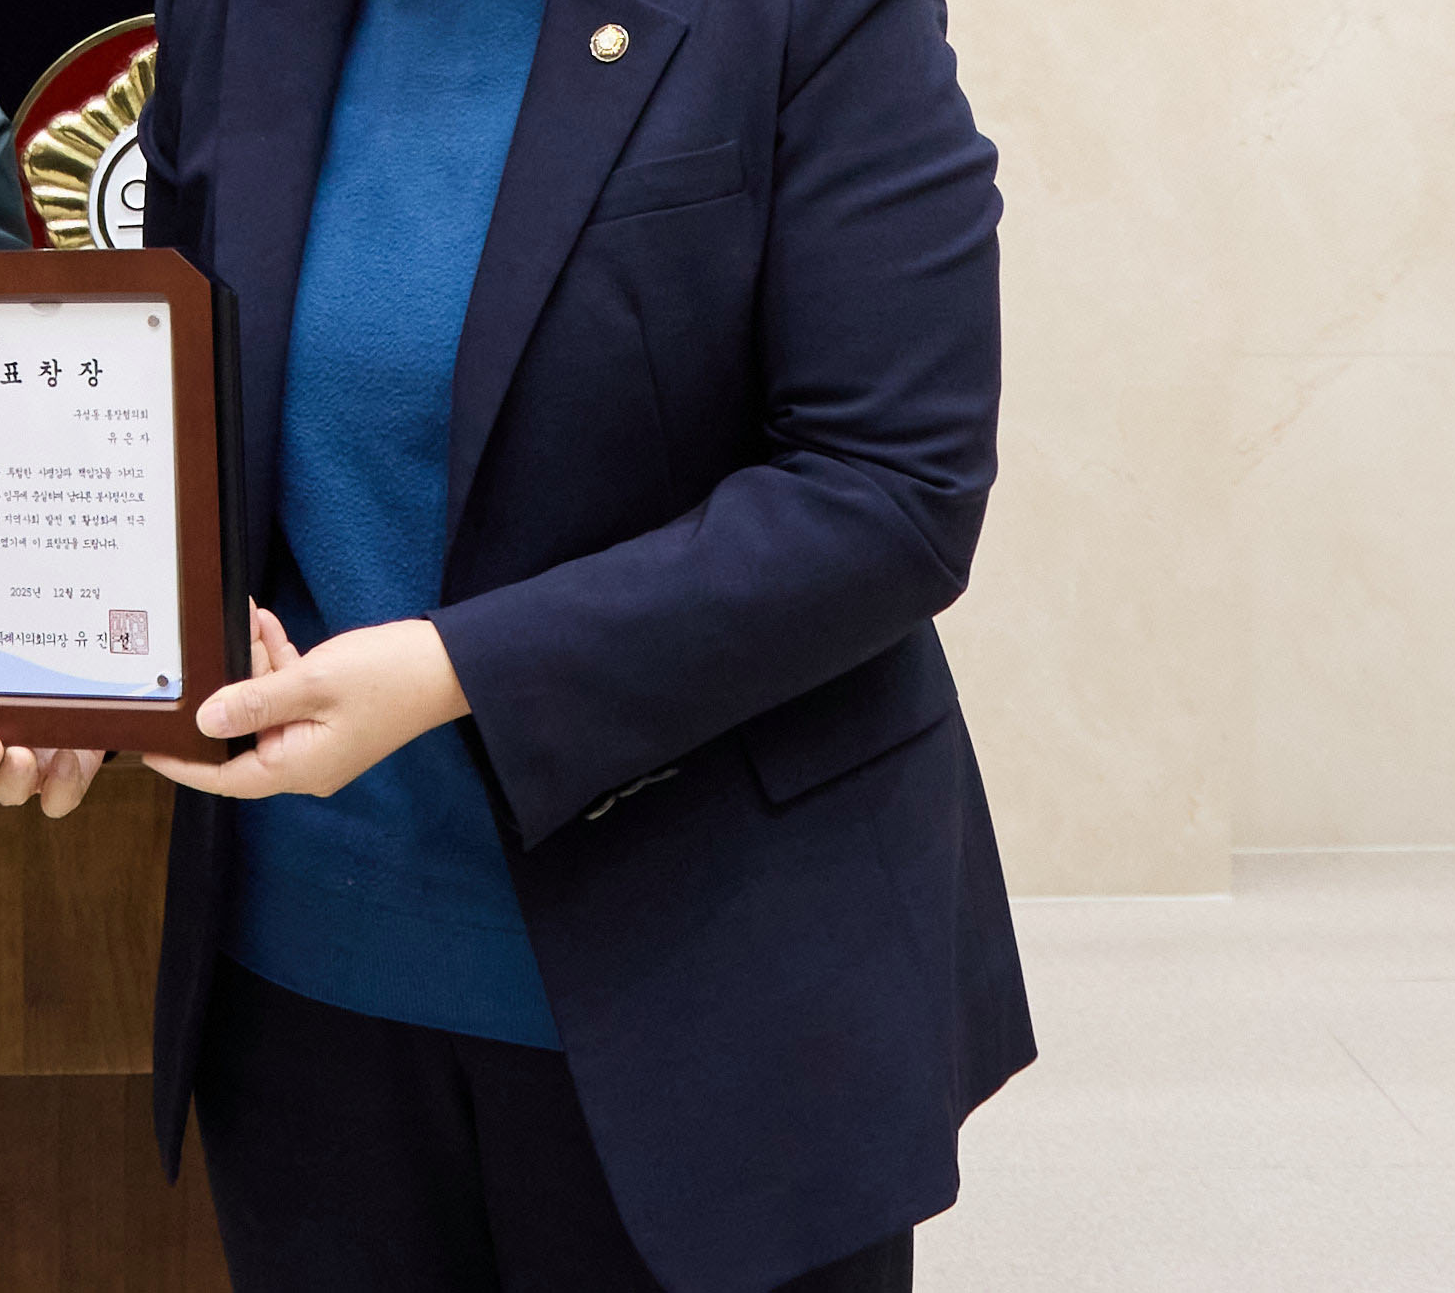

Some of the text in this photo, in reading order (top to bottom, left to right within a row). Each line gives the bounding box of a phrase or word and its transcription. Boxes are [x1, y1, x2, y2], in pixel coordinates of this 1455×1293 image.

[0, 358, 104, 388] 표창장
[9, 586, 101, 600] 2025년 12월 22일
